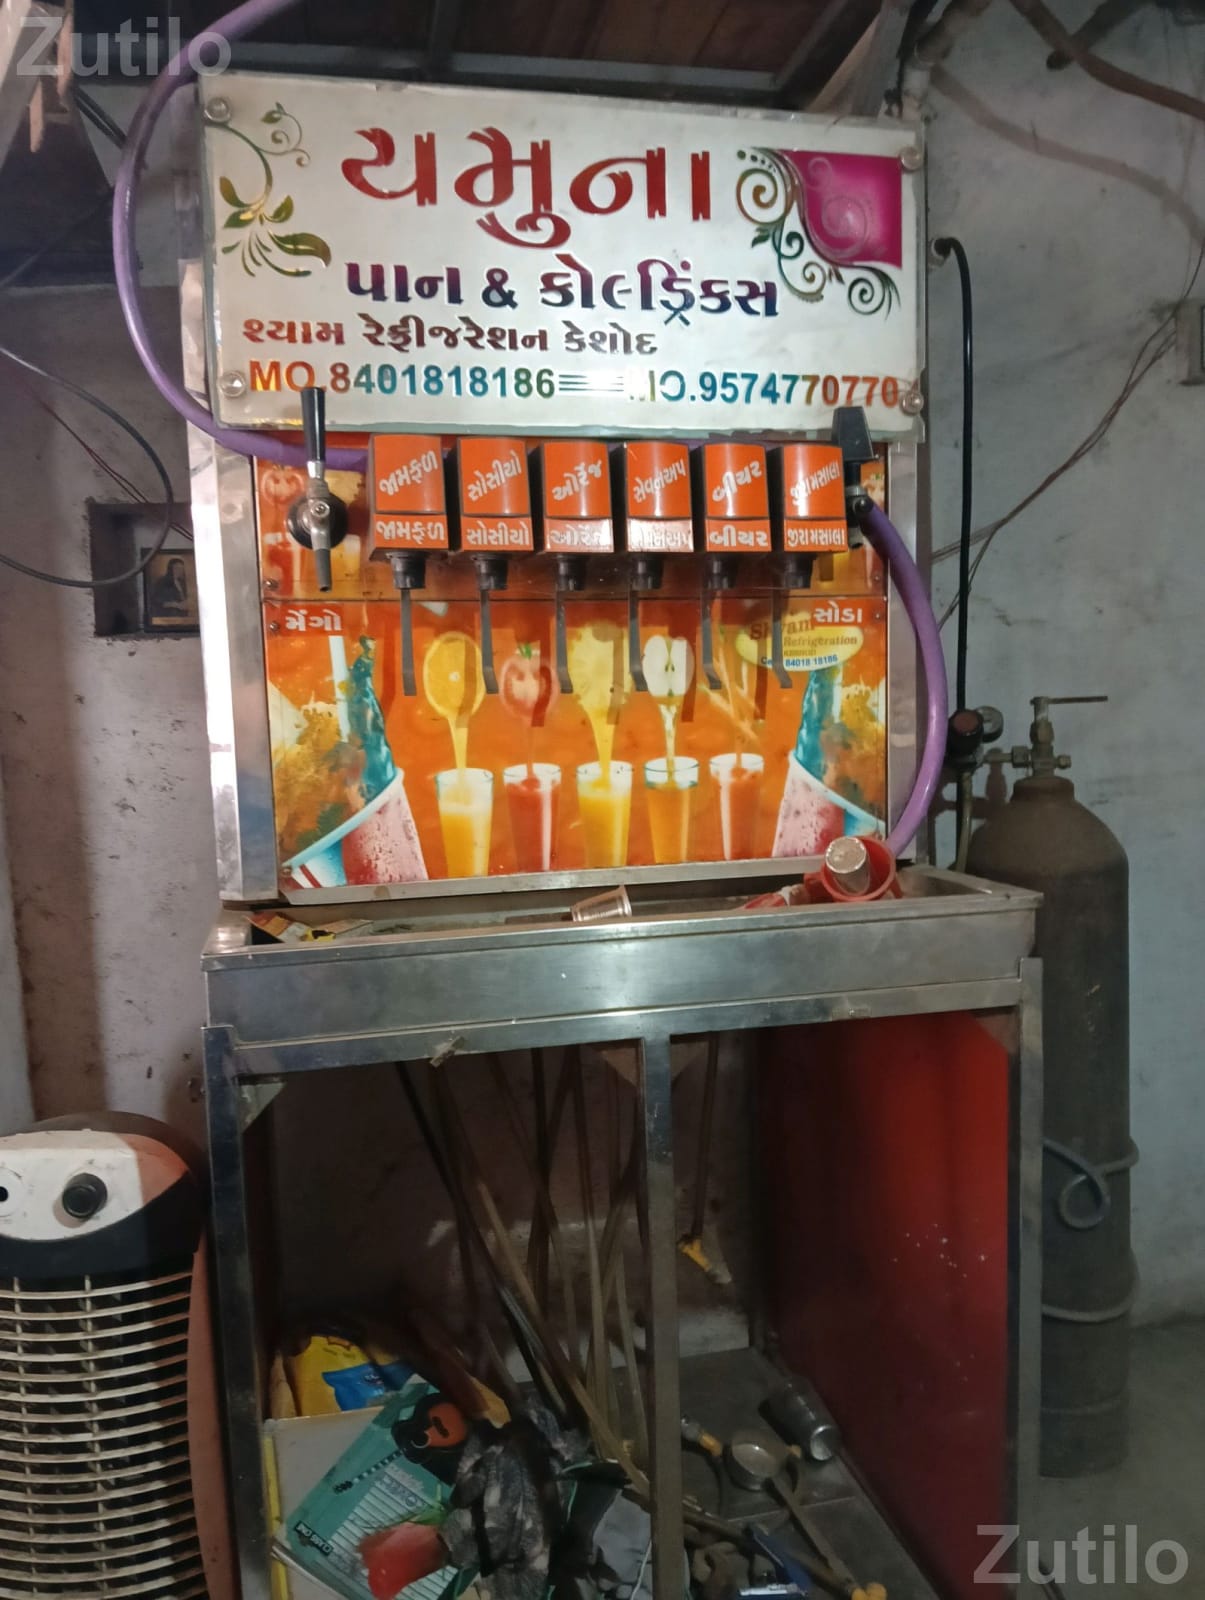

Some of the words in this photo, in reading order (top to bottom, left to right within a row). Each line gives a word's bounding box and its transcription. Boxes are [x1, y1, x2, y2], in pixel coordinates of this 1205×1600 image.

[341, 127, 711, 249] યમુના
[345, 262, 463, 305] પાન
[482, 267, 518, 309] &
[242, 318, 346, 347] શ્યામ
[564, 320, 658, 355] કેશોદ
[379, 450, 438, 496] જામફળ
[376, 520, 445, 545] જામફળ
[709, 524, 768, 548] બીયર
[813, 600, 863, 624] સોડા
